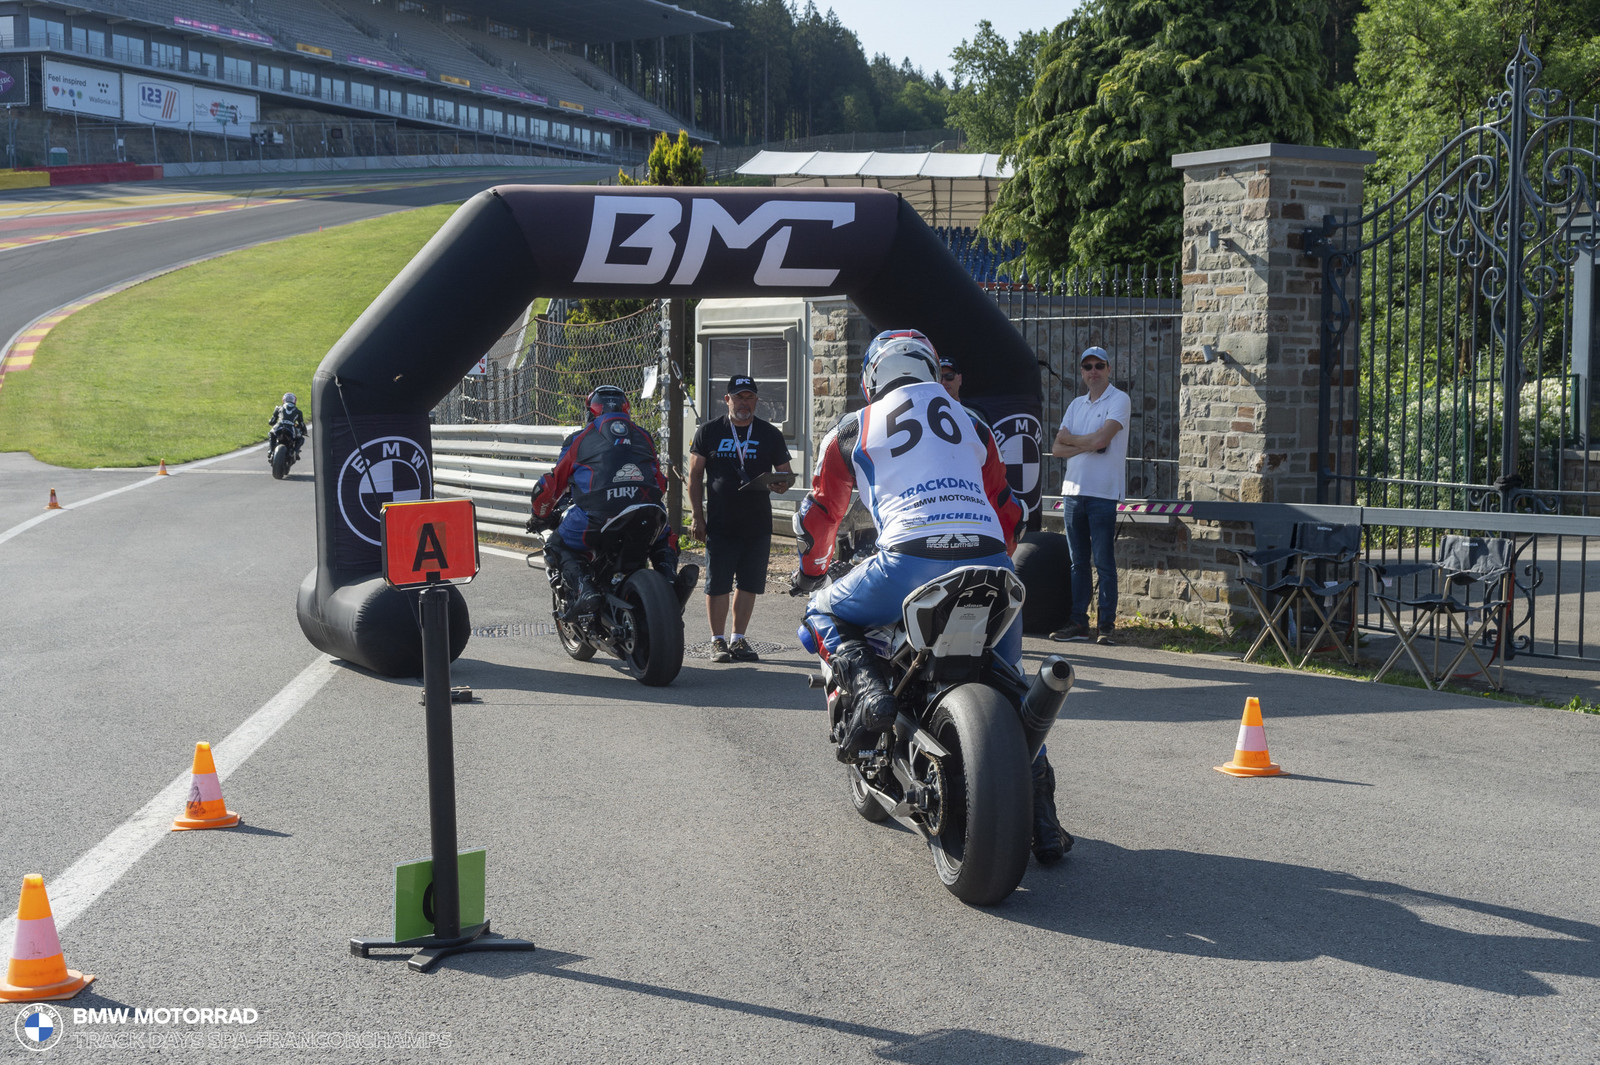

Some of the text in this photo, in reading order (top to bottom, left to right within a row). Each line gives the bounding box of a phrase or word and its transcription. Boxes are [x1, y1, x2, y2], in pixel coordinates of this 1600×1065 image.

[48, 73, 87, 87] Feel inspired
[141, 86, 162, 104] 123
[572, 195, 856, 287] BMC
[886, 396, 962, 458] 56
[350, 442, 425, 475] BMW
[606, 486, 640, 501] FURY
[898, 477, 982, 500] TRACKDAYS
[913, 494, 986, 509] BMW MOTORRAD
[926, 512, 992, 523] MICHELIN
[411, 522, 449, 573] A
